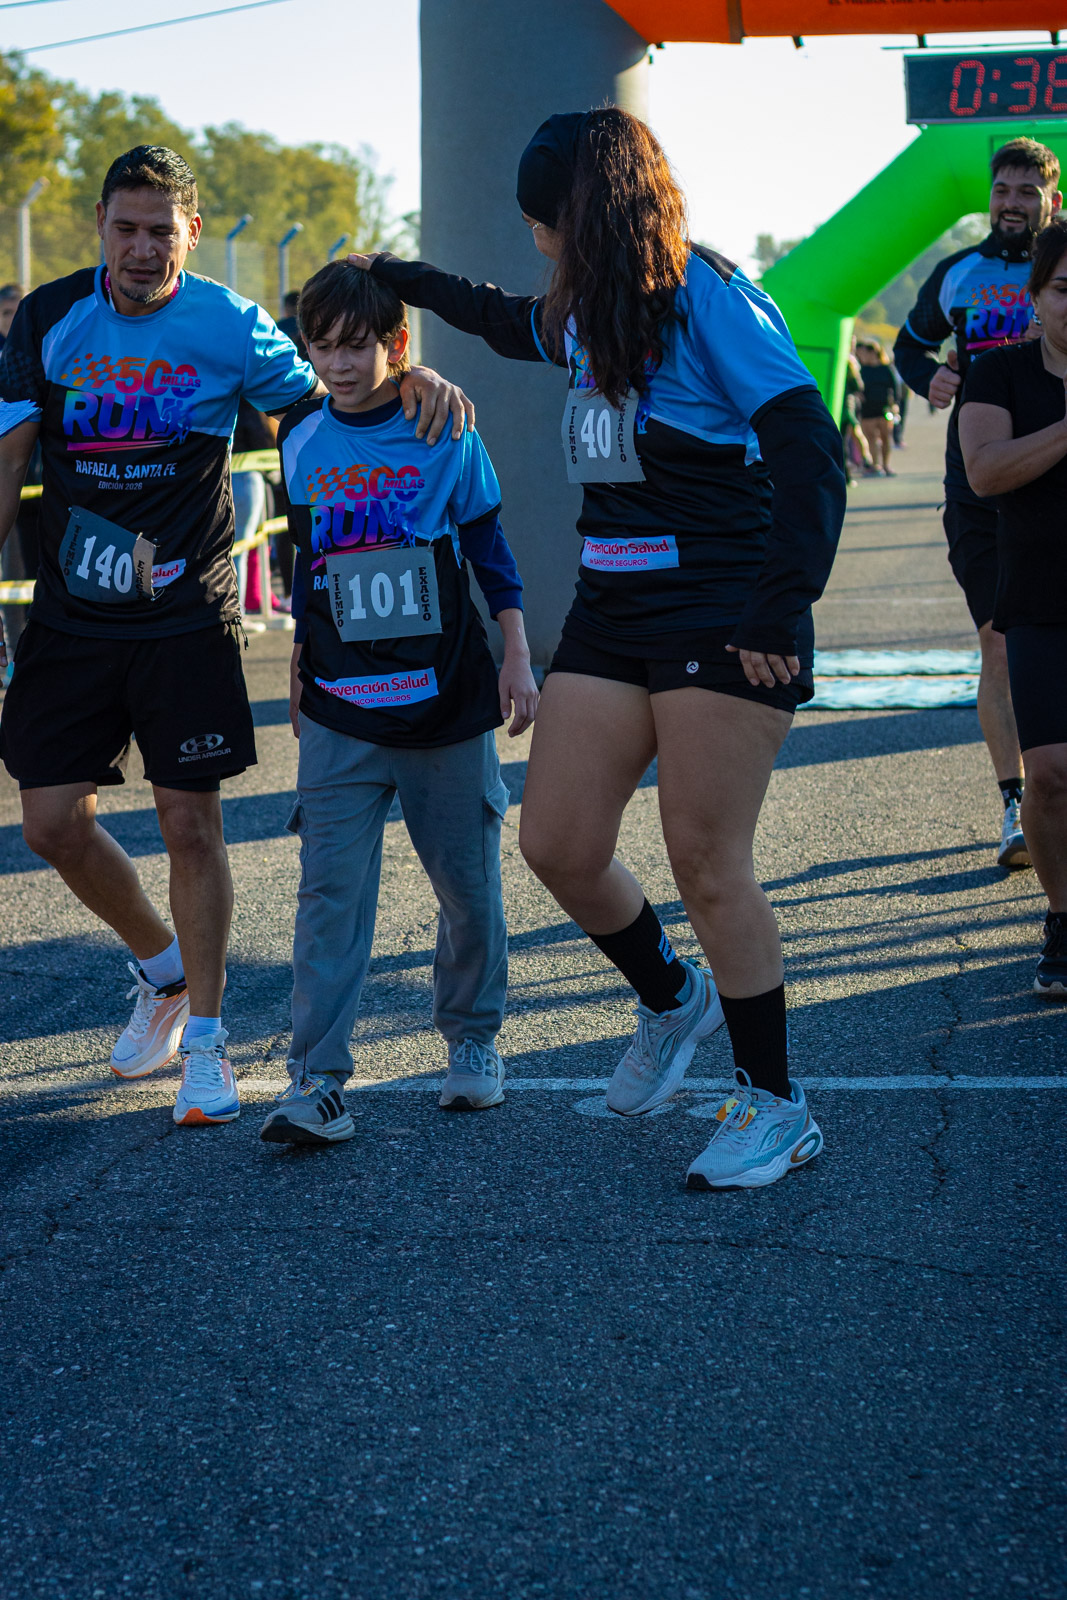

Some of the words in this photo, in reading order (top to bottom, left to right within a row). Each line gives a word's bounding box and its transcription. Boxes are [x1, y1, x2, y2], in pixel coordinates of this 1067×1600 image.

[115, 356, 198, 399] 500
[160, 375, 202, 388] MILLAS
[63, 391, 175, 440] RUN
[568, 406, 577, 465] TIEMPO
[580, 408, 611, 459] 40
[617, 403, 627, 463] EXACTO
[75, 460, 120, 481] RAFAELA,
[124, 464, 163, 479] SANTA
[163, 462, 177, 476] FE
[97, 481, 124, 490] EDICIÓN
[344, 464, 421, 502] 500
[383, 479, 425, 489] MILLAS
[309, 500, 401, 554] RUN
[630, 539, 669, 554] Salud
[64, 524, 82, 577] TIEMPO
[76, 535, 133, 594] 140
[615, 558, 648, 567] SEGUROS
[152, 564, 179, 578] alud
[333, 573, 344, 628] TIEMPO
[348, 569, 419, 620] 101
[418, 566, 432, 622] EXACTO
[376, 694, 411, 703] SEGUROS
[390, 673, 429, 691] Salud
[178, 755, 201, 763] UNDER
[202, 747, 232, 759] ARMOUR
